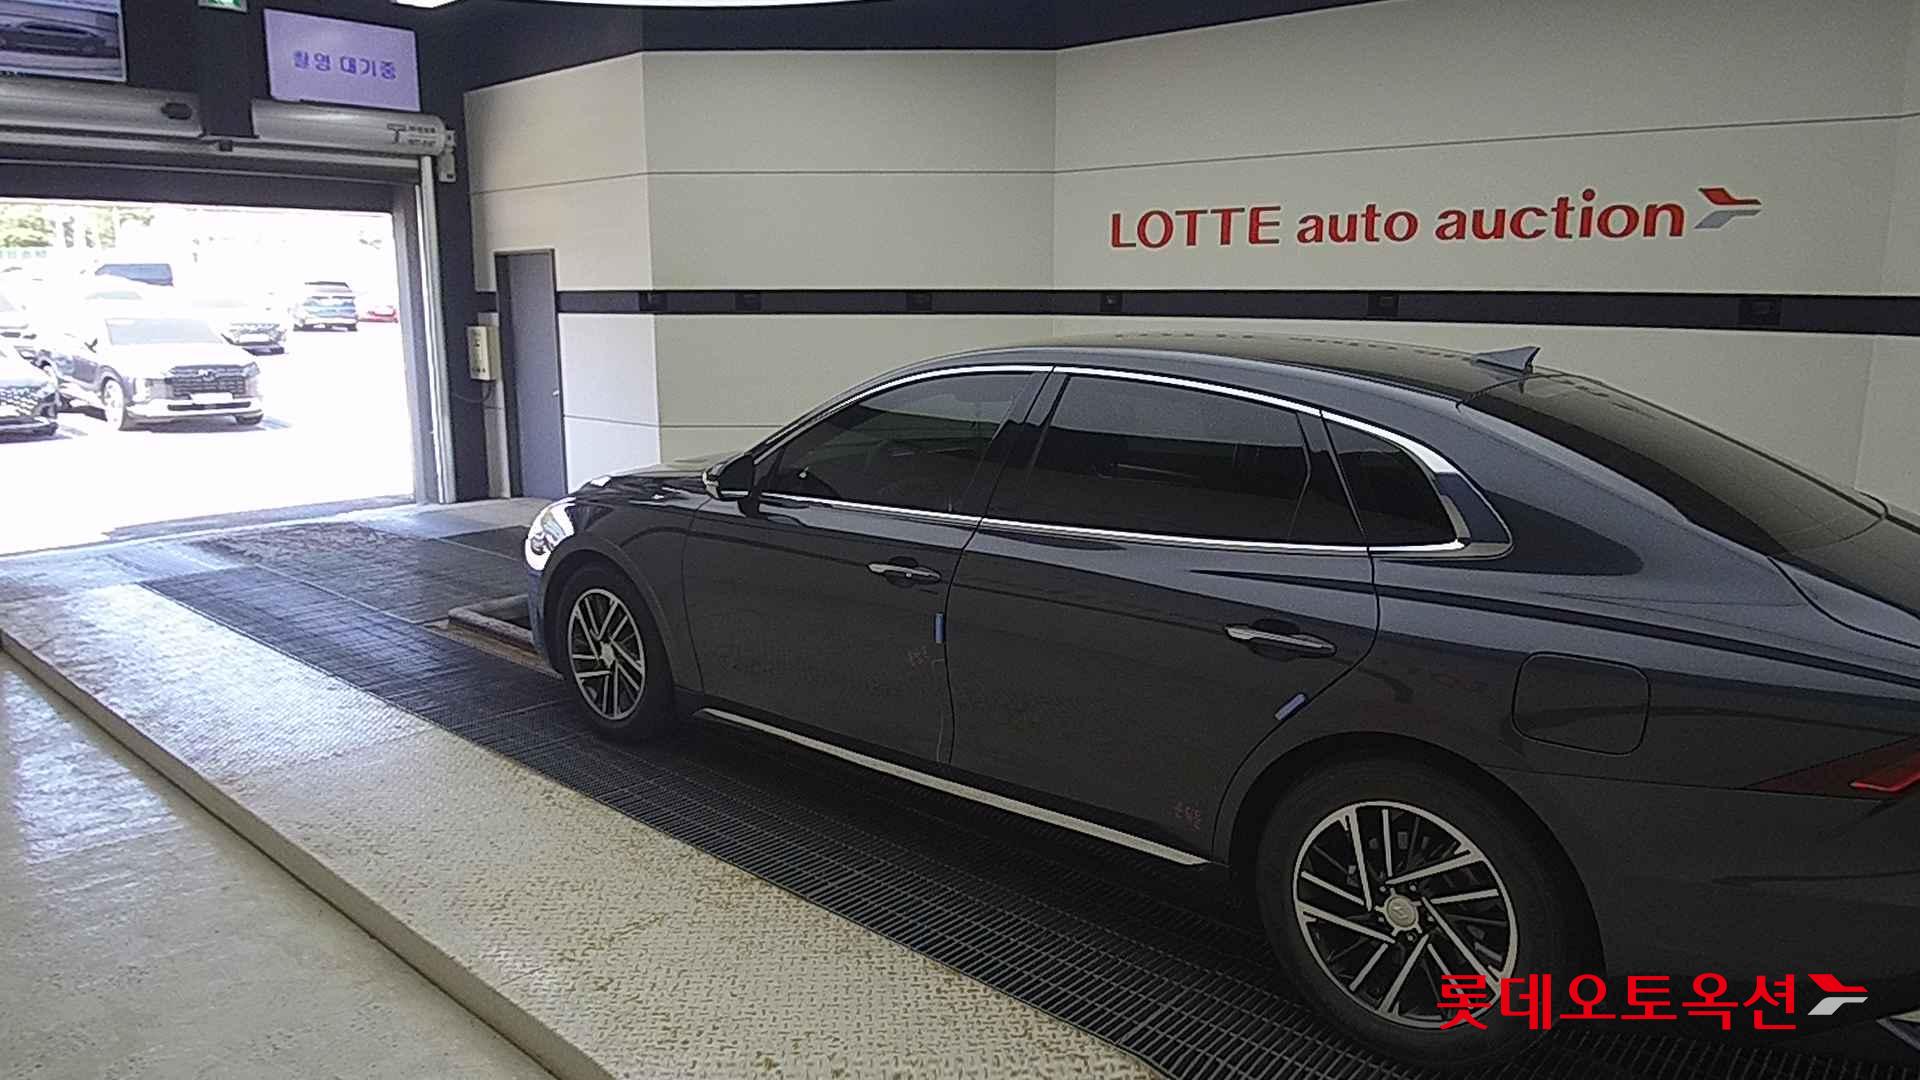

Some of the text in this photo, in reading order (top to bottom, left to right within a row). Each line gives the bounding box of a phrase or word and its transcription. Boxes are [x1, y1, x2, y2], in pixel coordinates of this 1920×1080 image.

[340, 55, 397, 80] 대기중
[1111, 189, 1686, 249] LOTTE auto auction
